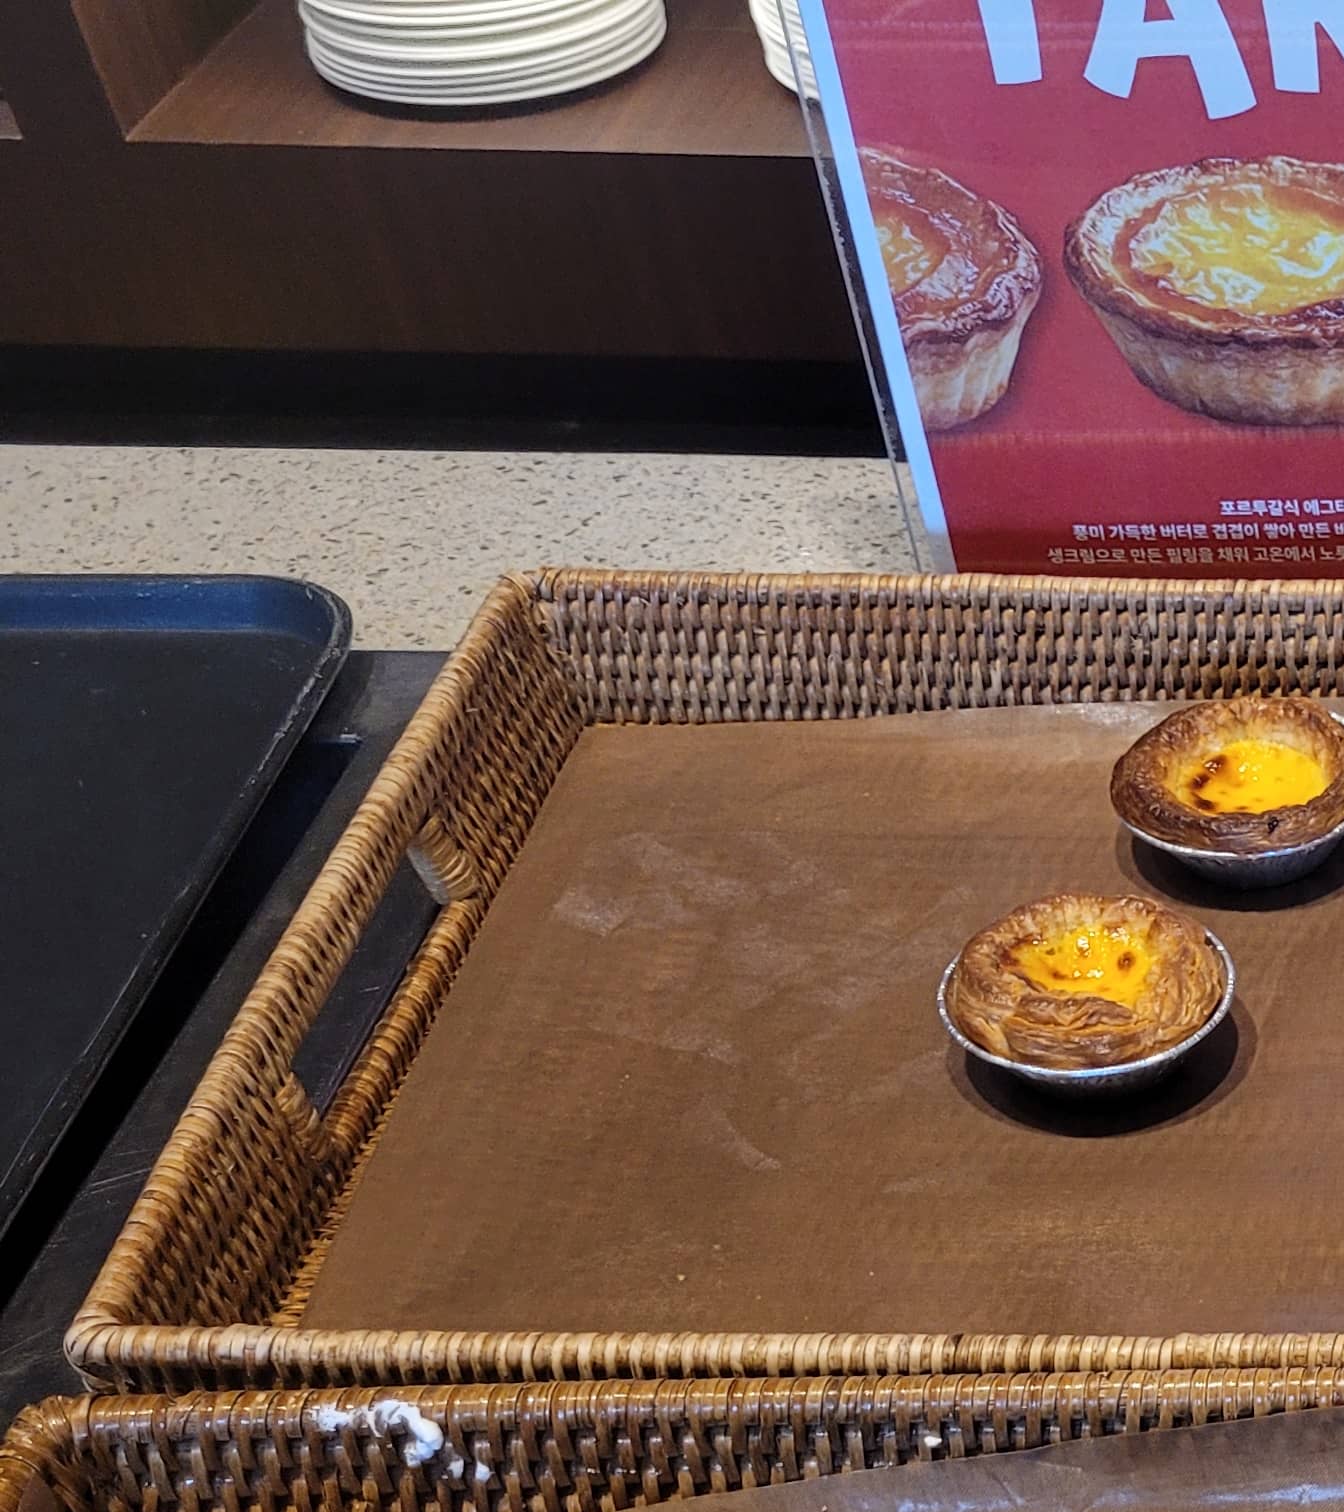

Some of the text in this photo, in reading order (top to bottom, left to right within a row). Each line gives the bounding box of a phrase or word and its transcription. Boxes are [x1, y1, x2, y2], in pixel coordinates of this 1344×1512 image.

[1220, 499, 1300, 516] 포르투갈식
[1072, 524, 1104, 541] 풍미
[1109, 524, 1157, 541] 가득한
[1160, 524, 1208, 540] 버터로
[1212, 523, 1260, 540] 겹겹이
[1299, 522, 1330, 539] 만든
[1048, 547, 1129, 565] 생크림으로
[1130, 547, 1162, 564] 만든
[1165, 546, 1213, 564] 필링을
[1217, 545, 1249, 563] 채워
[1253, 545, 1316, 562] 고온에서
